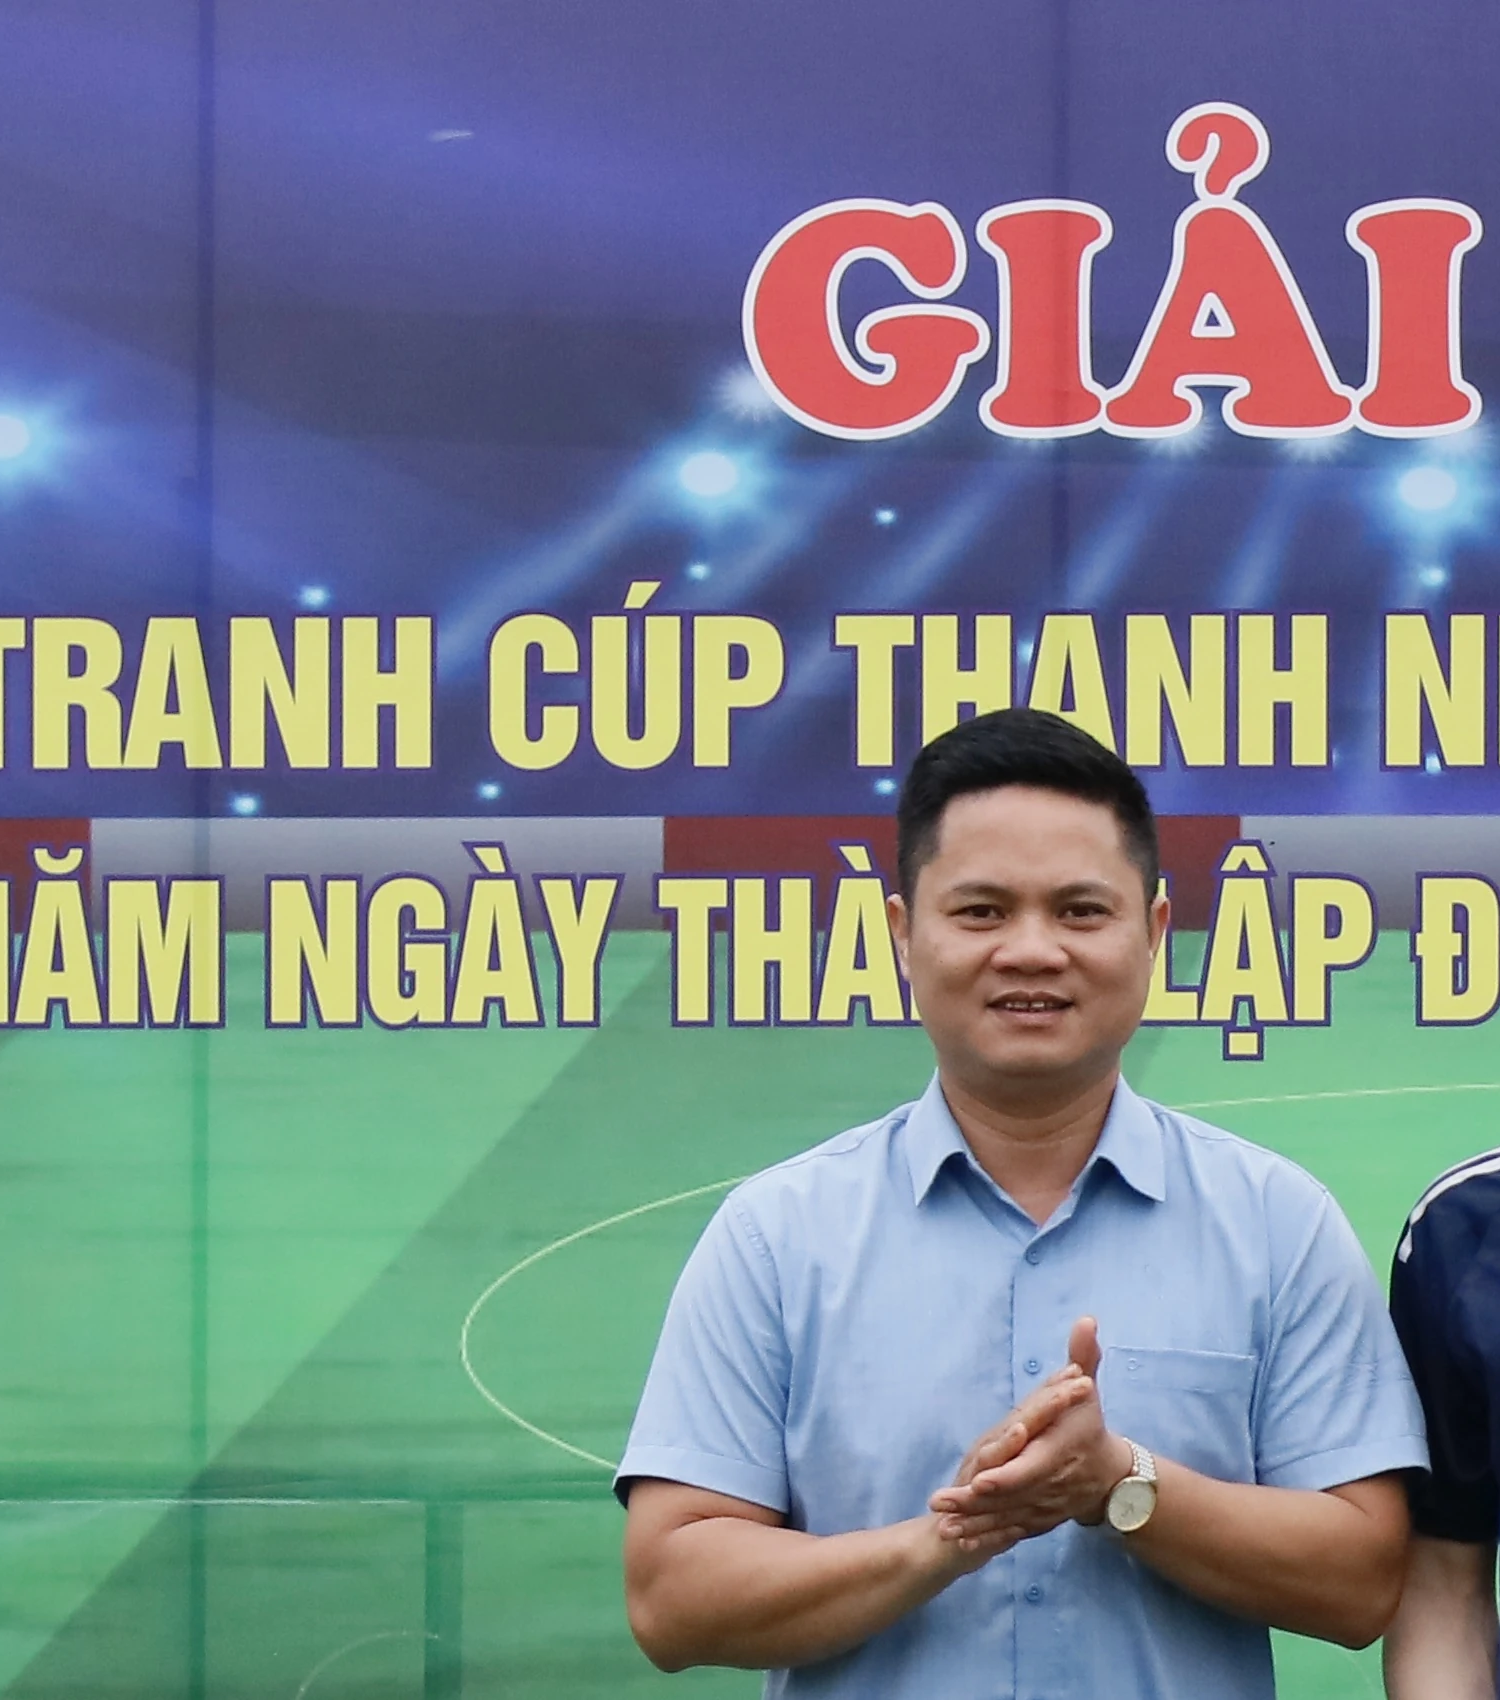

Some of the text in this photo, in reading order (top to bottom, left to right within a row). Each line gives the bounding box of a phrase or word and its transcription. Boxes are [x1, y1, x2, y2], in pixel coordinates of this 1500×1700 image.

[747, 106, 1478, 436] GIẢI
[490, 581, 783, 769] CÚP
[836, 614, 1328, 766] THANH
[269, 846, 617, 1026] NGÀY
[658, 845, 910, 1022] THÀ
